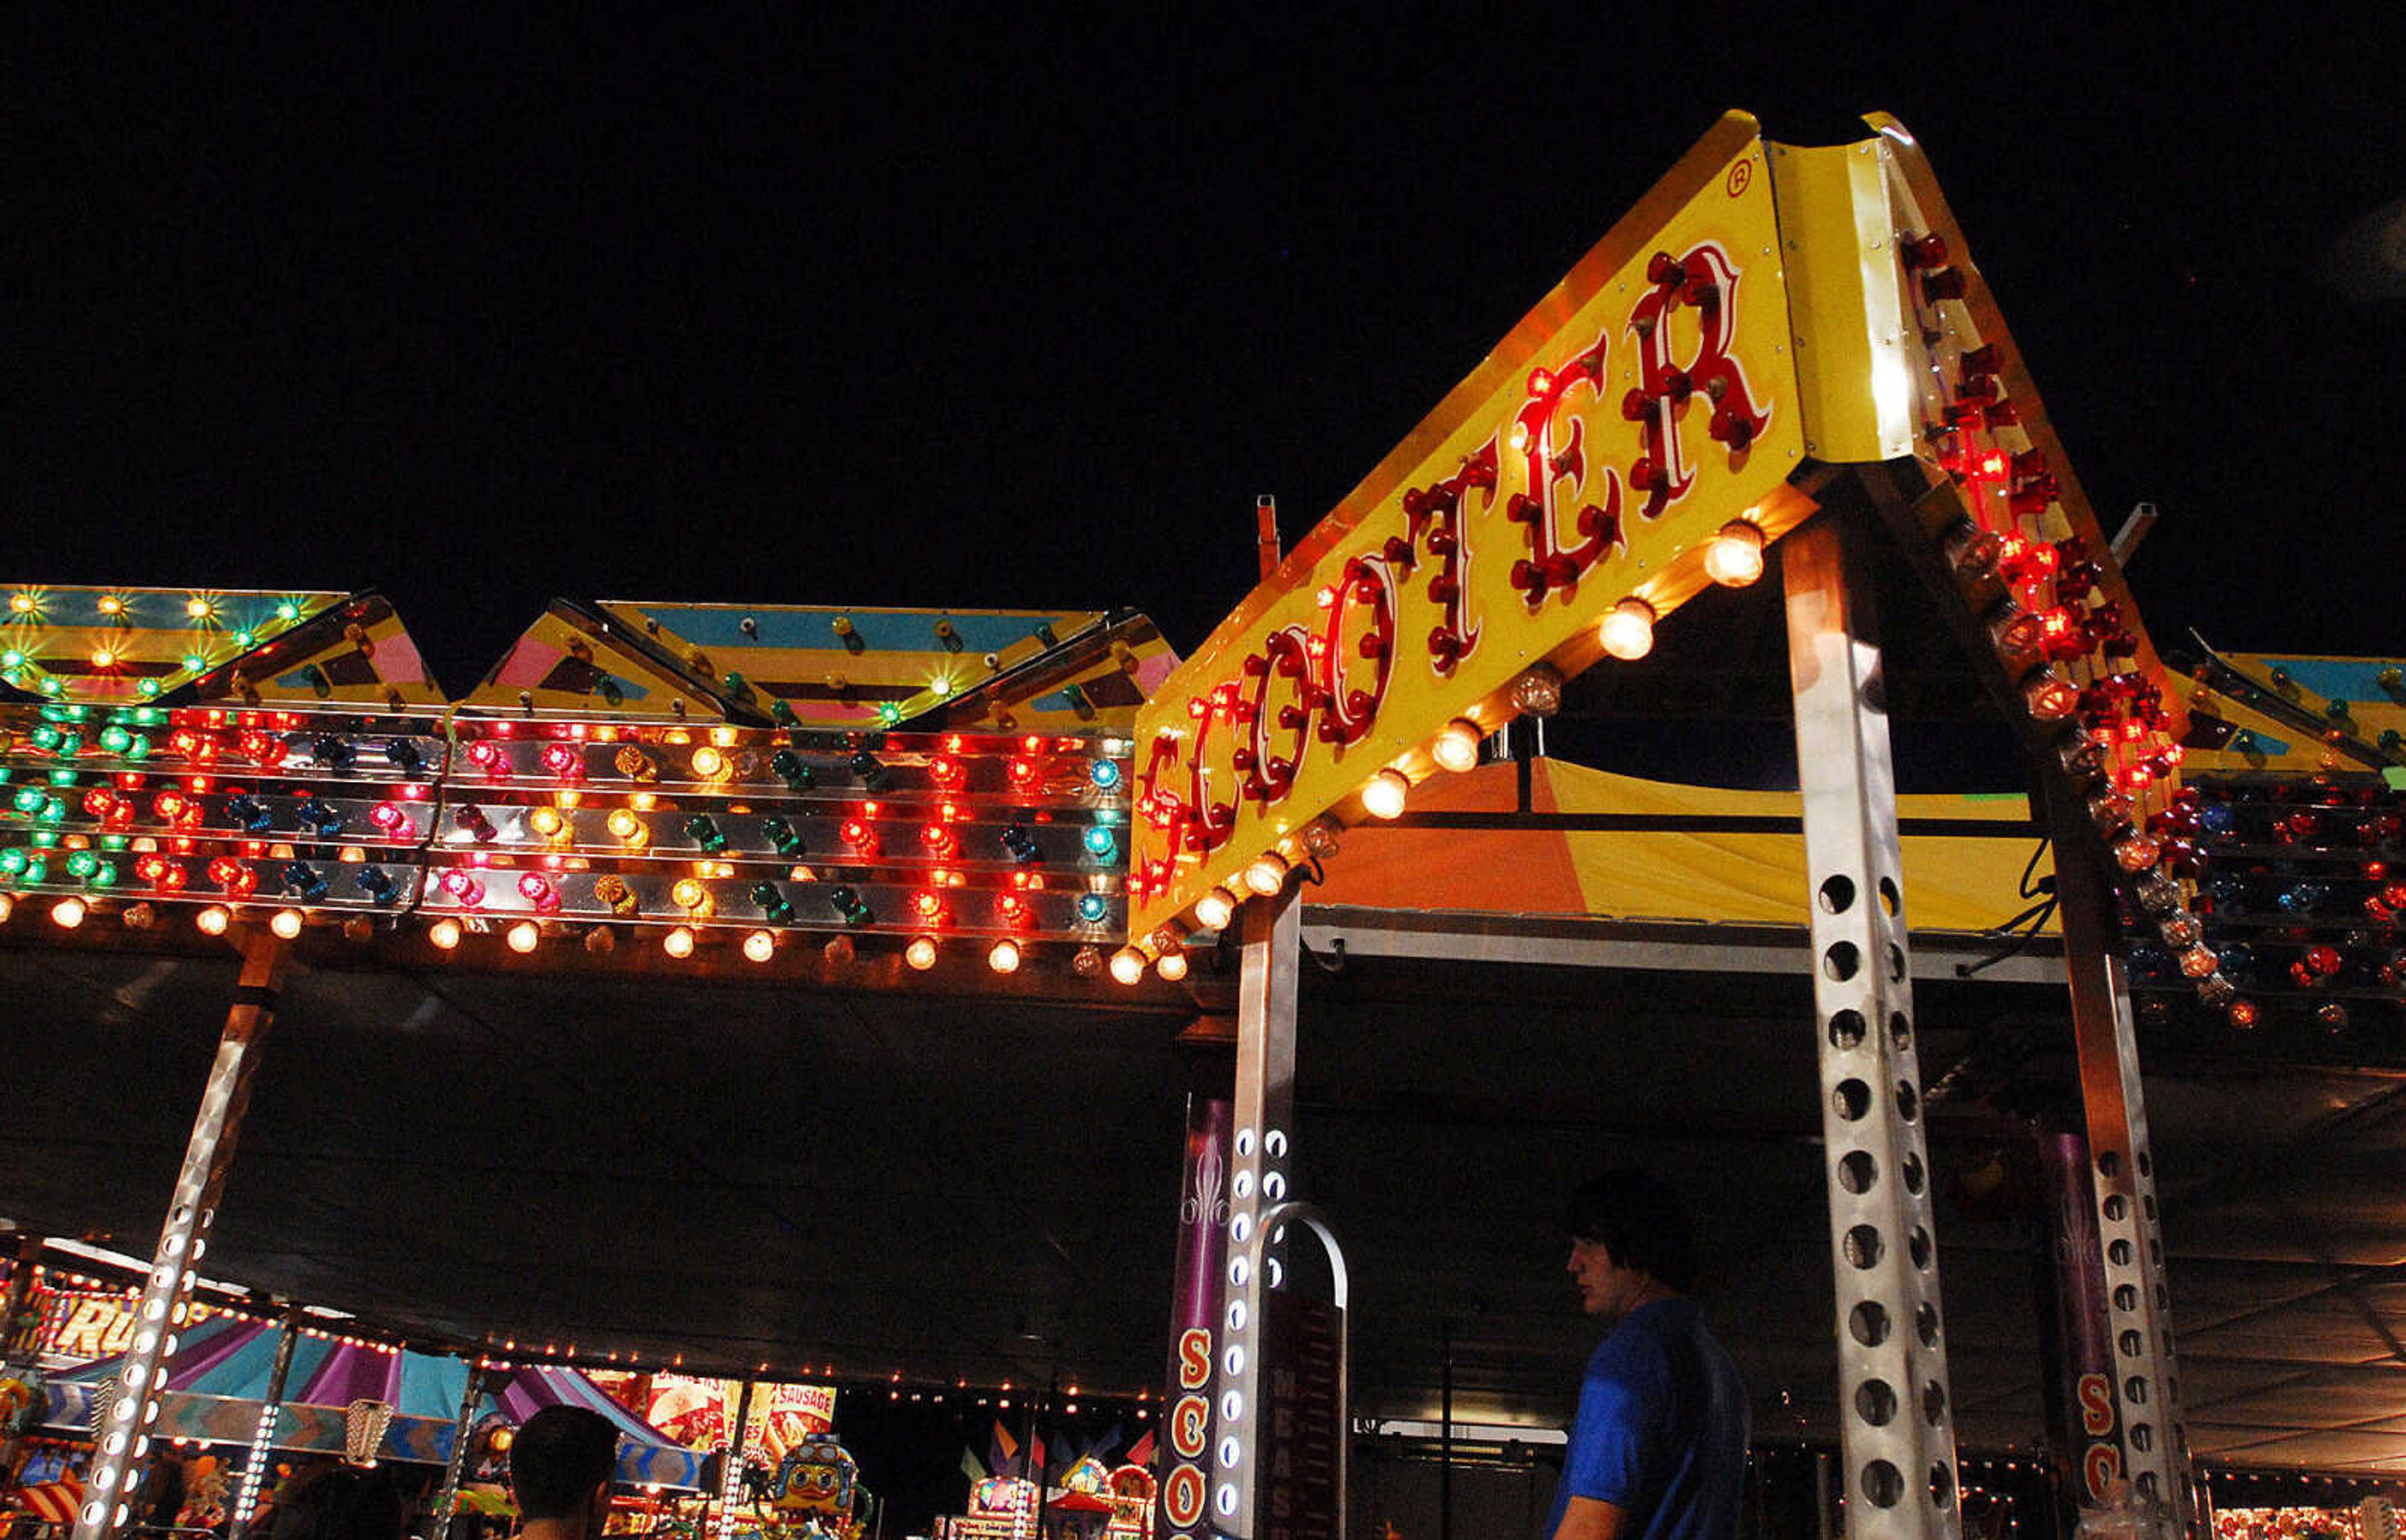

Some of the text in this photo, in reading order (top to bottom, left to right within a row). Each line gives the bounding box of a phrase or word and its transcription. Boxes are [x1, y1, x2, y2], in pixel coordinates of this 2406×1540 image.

[1129, 240, 1771, 910] SCOOTER
[779, 1387, 831, 1413] SAUSAGE
[1164, 1327, 1212, 1540] SCO
